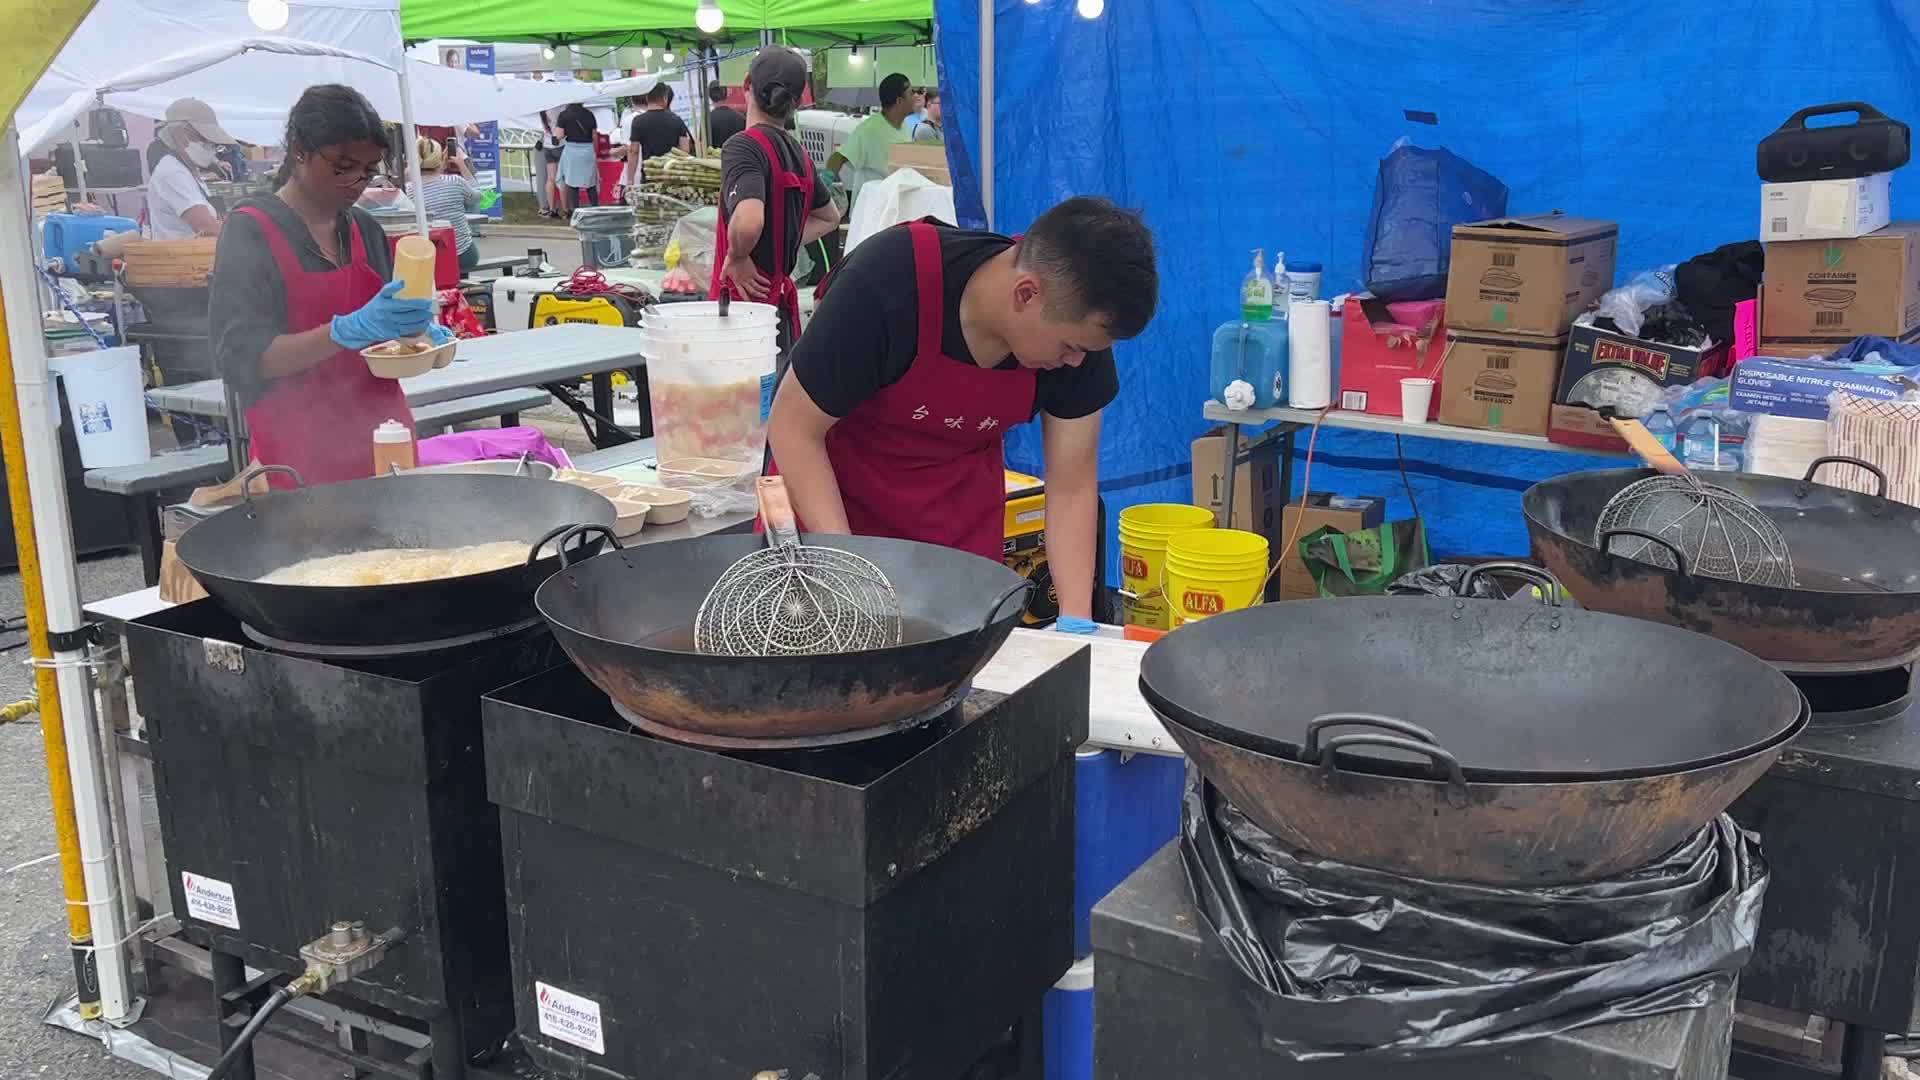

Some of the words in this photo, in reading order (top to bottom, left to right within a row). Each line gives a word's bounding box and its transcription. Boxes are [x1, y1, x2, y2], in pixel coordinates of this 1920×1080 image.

[1737, 376, 1771, 388] GLOVES
[1739, 368, 1795, 383] DISPOSABLE
[1796, 375, 1831, 387] NITRILE
[1832, 380, 1898, 397] EXAMINATION
[1735, 390, 1762, 399] EXAMEN
[1763, 393, 1787, 402] NITRILE
[1186, 592, 1217, 612] ALFA
[196, 885, 233, 904] Anderson
[551, 1000, 598, 1024] Anderson
